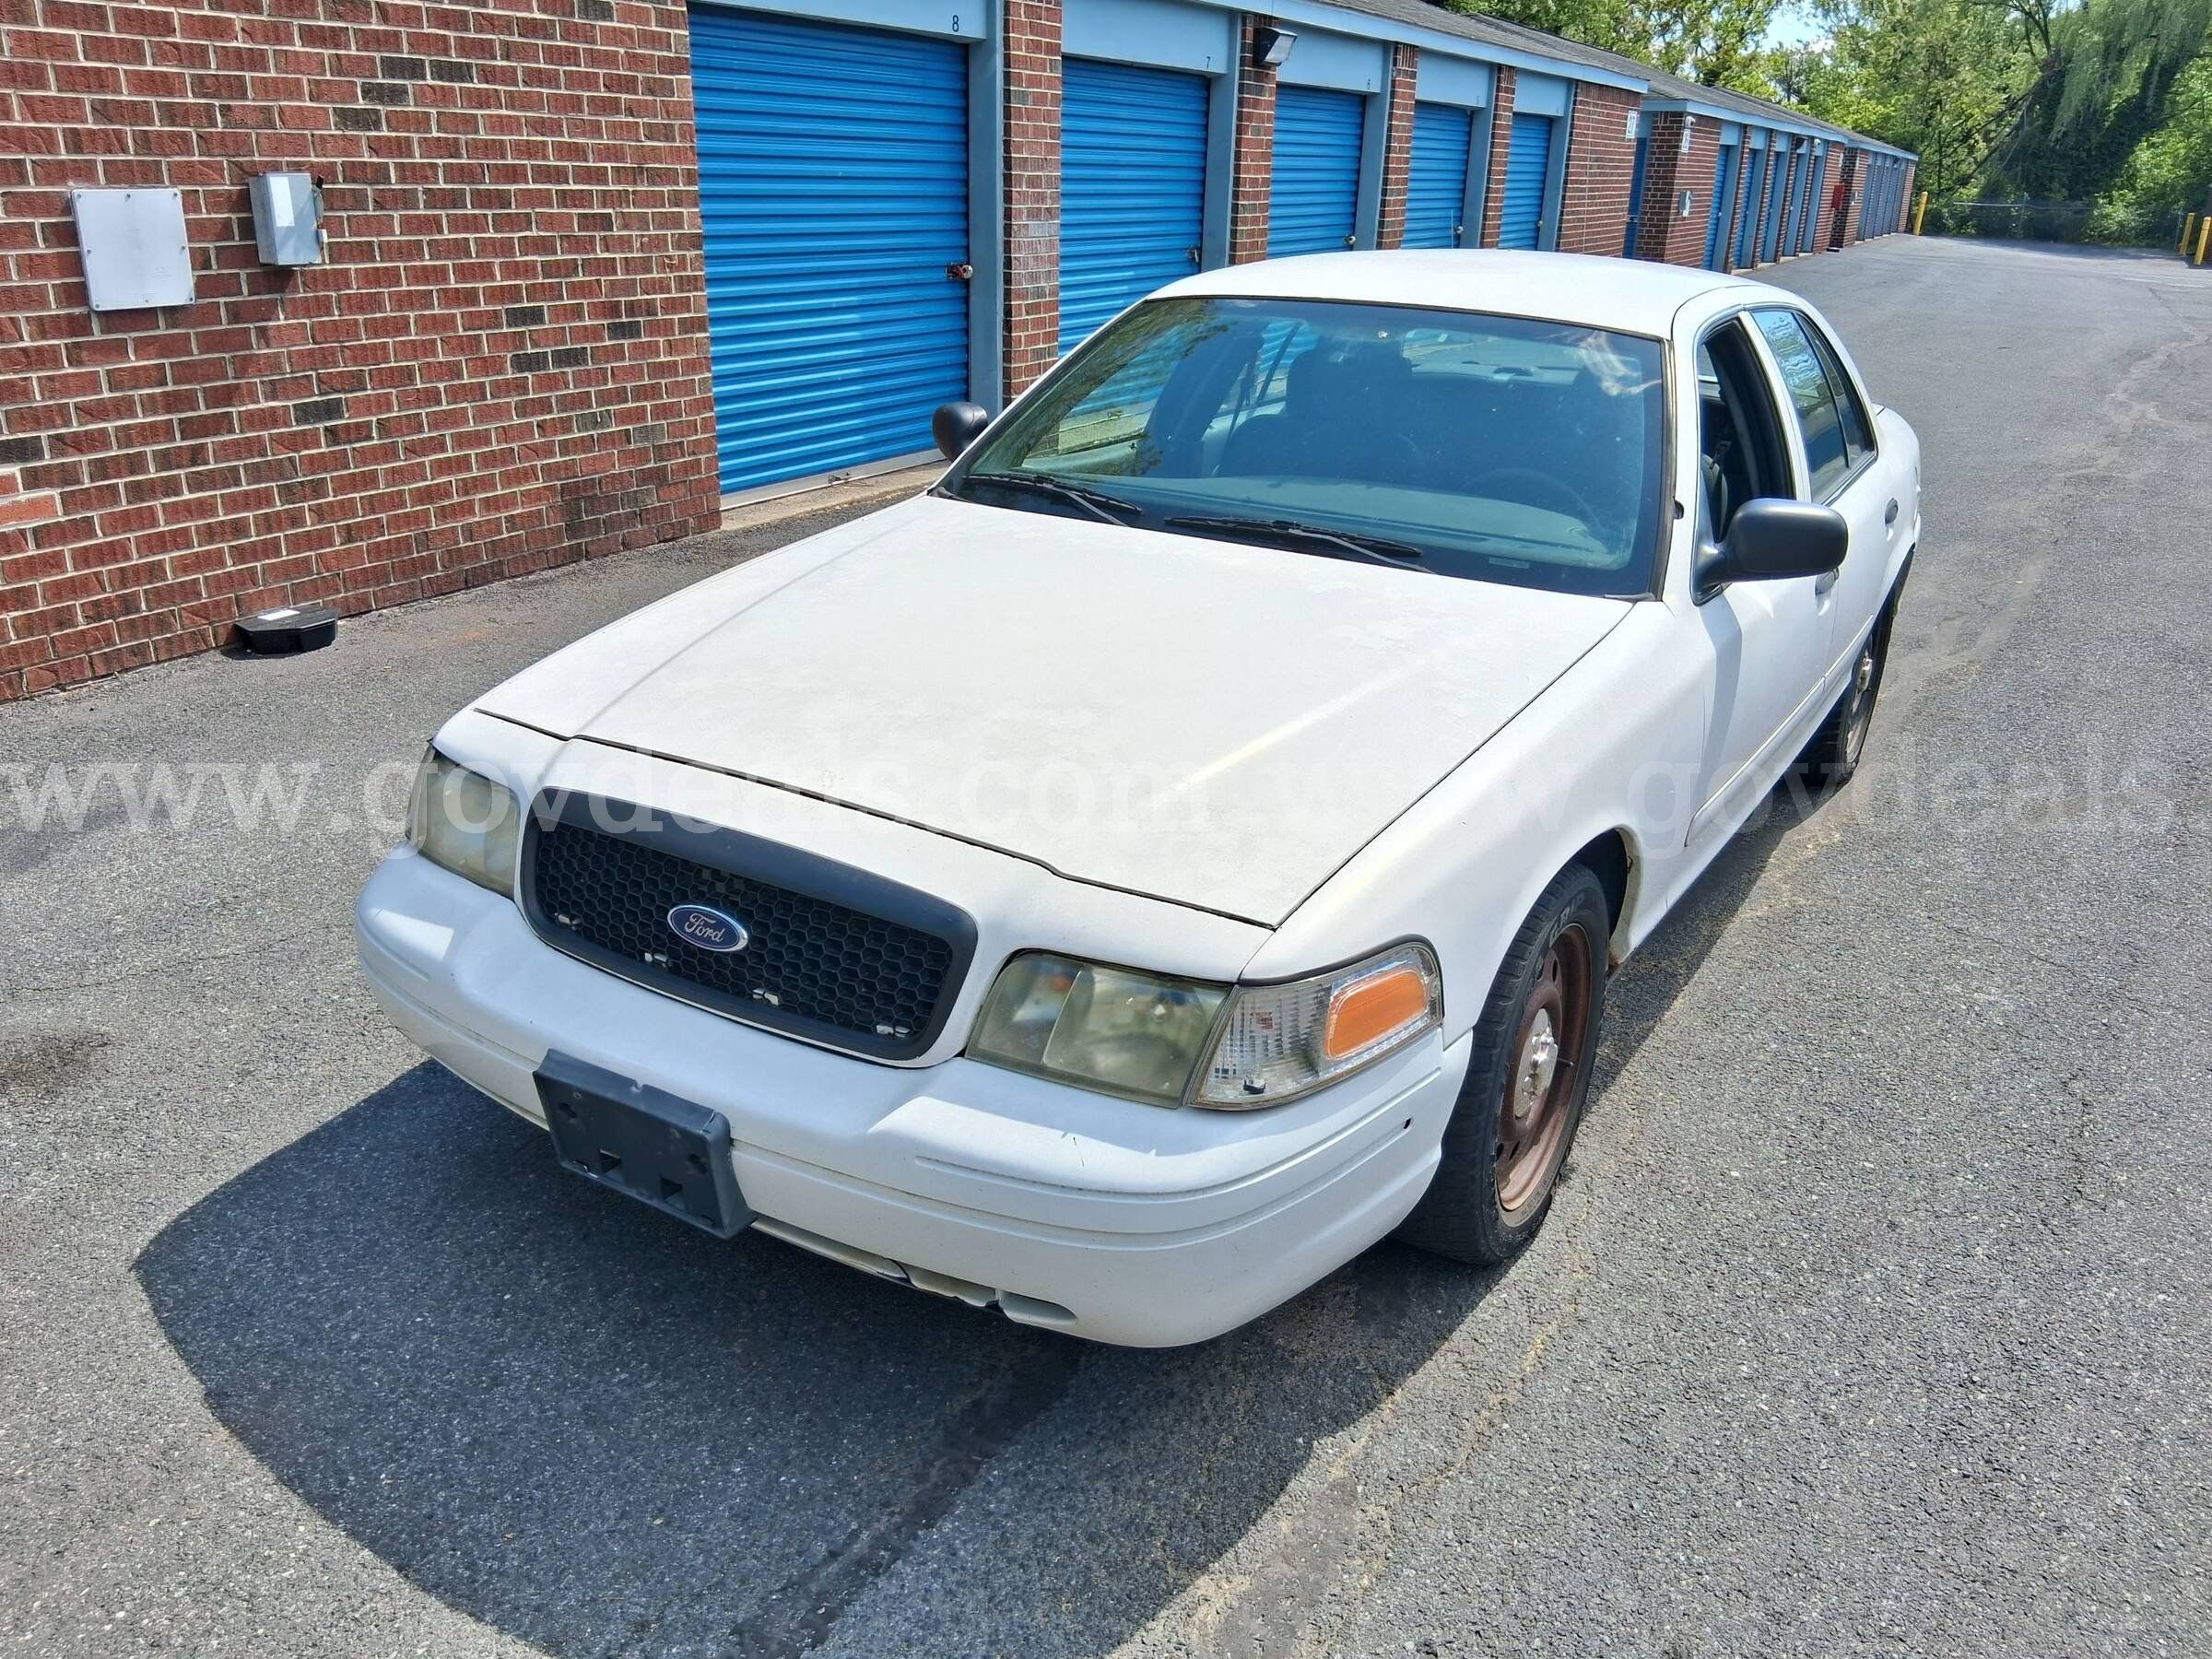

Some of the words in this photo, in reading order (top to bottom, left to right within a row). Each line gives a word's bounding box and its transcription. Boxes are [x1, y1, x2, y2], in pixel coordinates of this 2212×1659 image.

[952, 15, 959, 32] 8
[1206, 55, 1211, 70] 7
[685, 913, 725, 942] Ford
